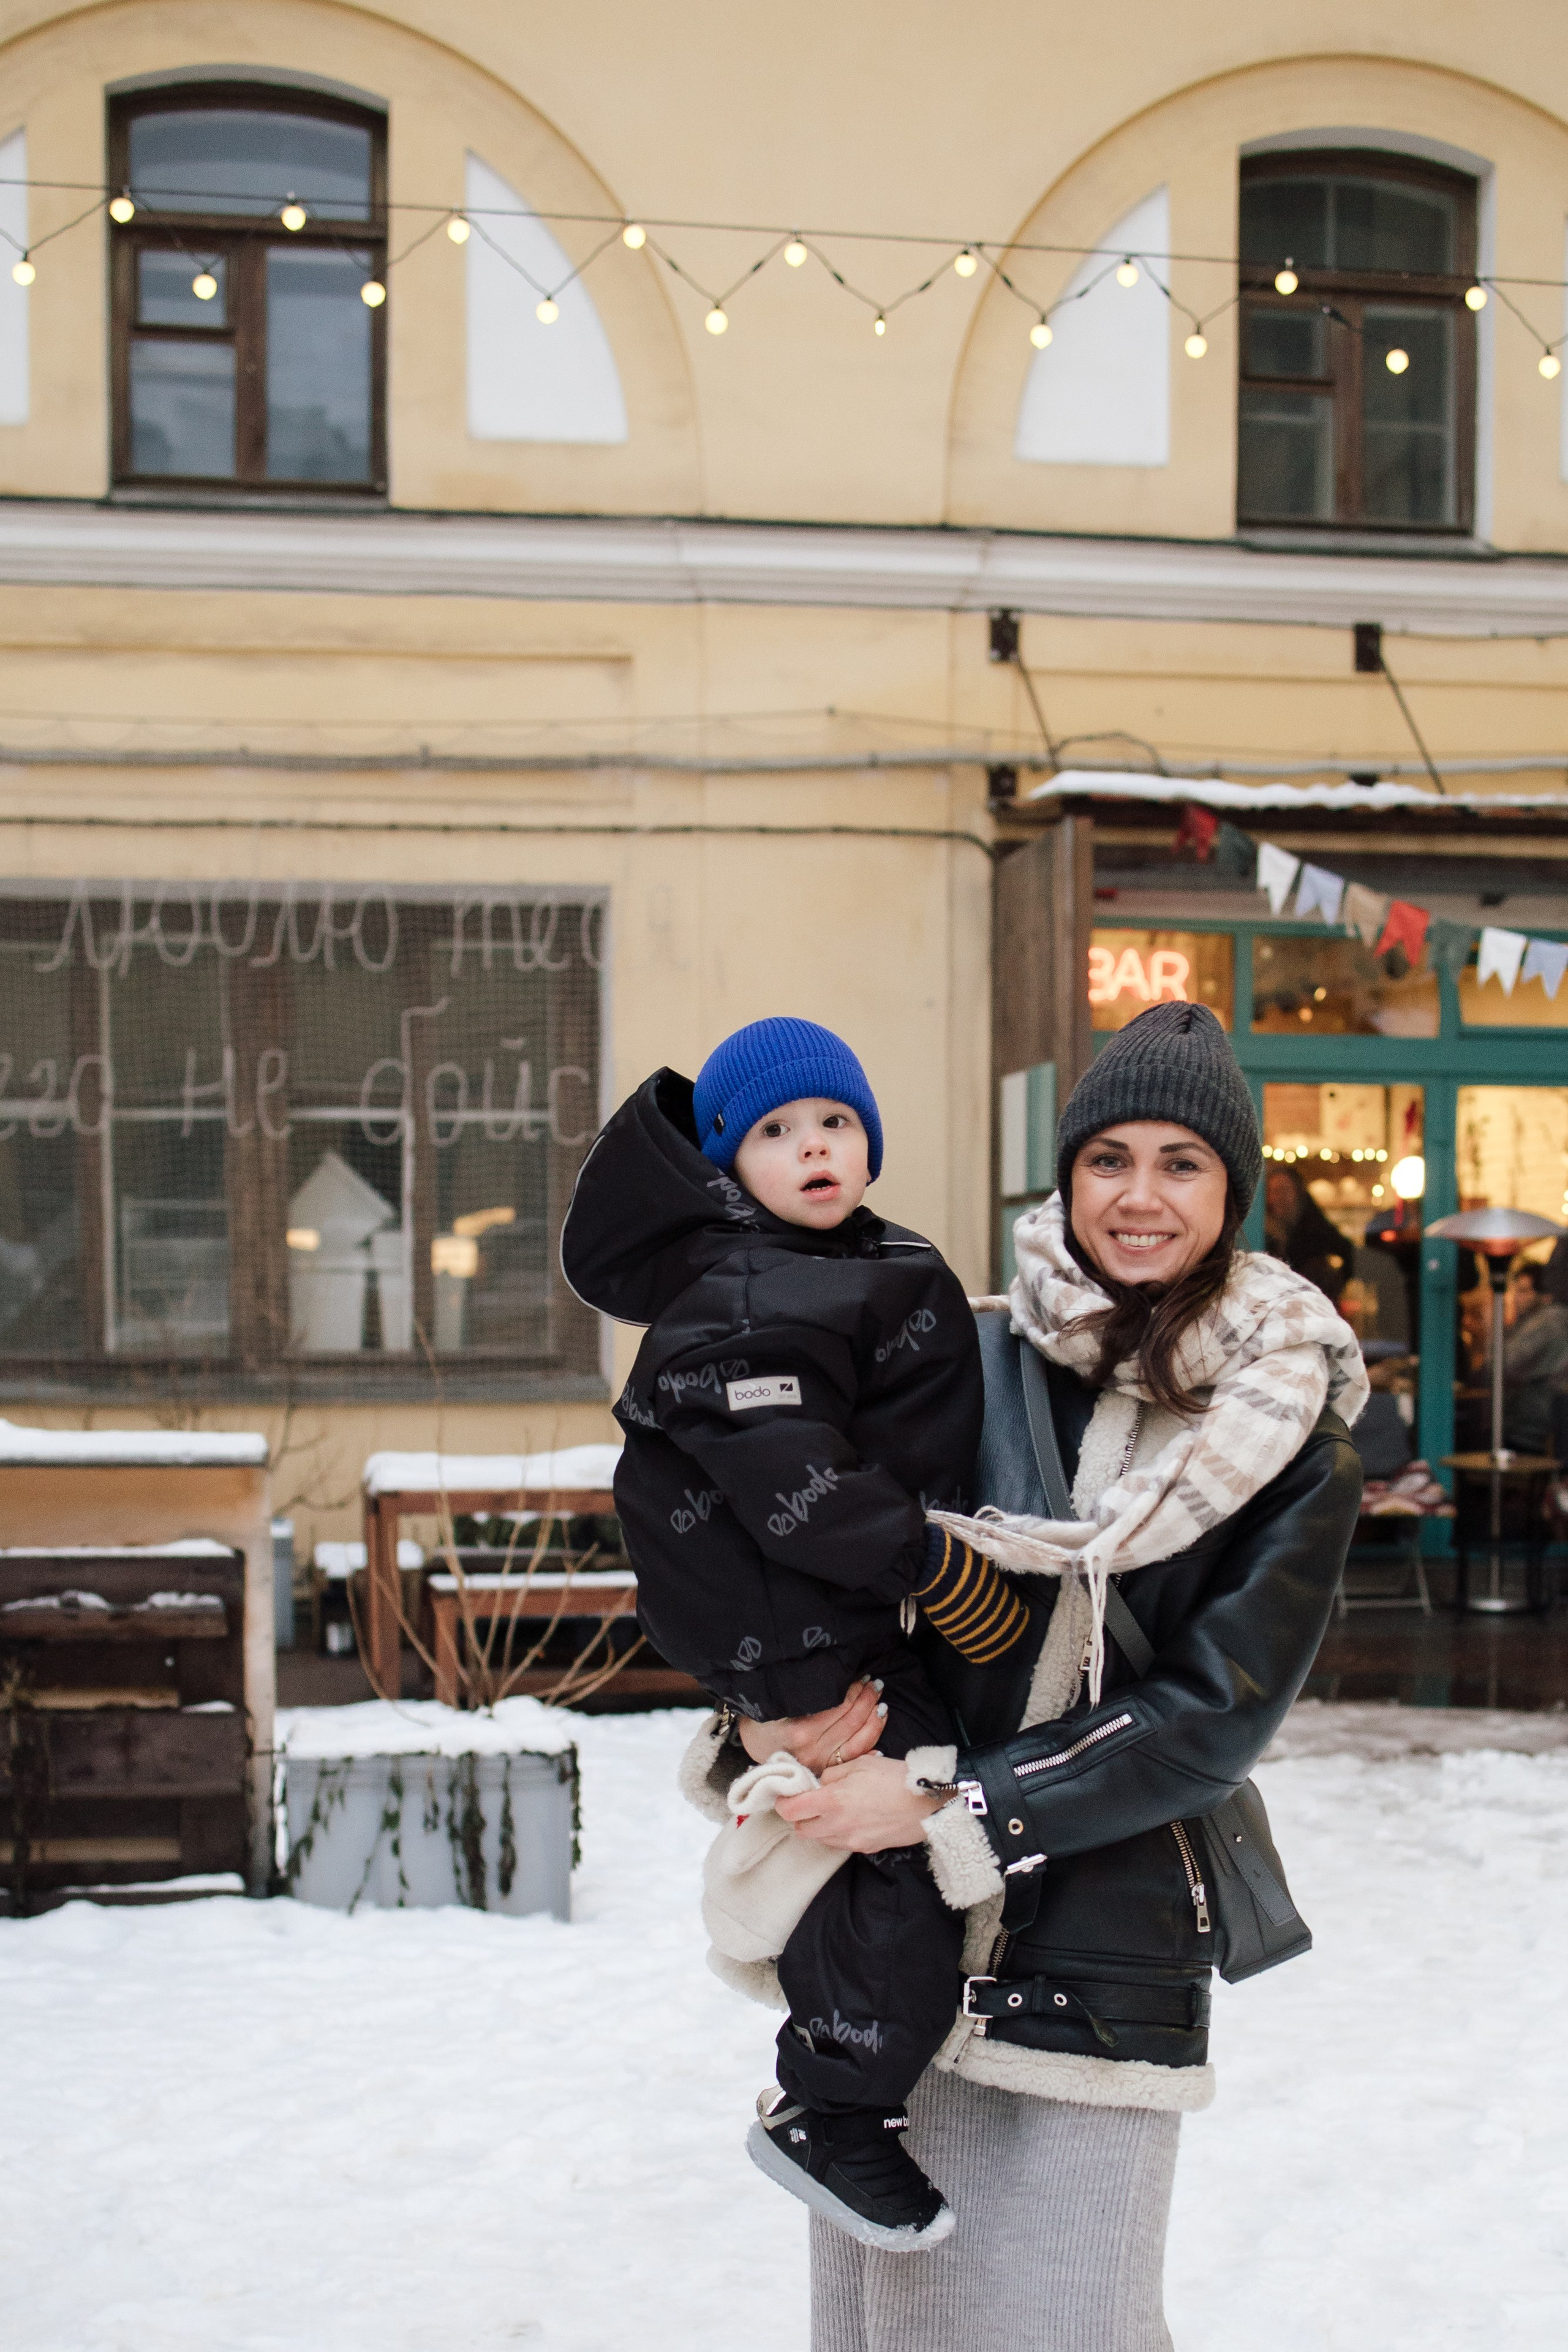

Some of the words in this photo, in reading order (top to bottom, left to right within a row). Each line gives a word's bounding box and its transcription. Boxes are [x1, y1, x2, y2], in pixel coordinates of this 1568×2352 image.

[1088, 947, 1190, 1001] BAR
[734, 1385, 772, 1401] bodo
[883, 2117, 903, 2129] new
